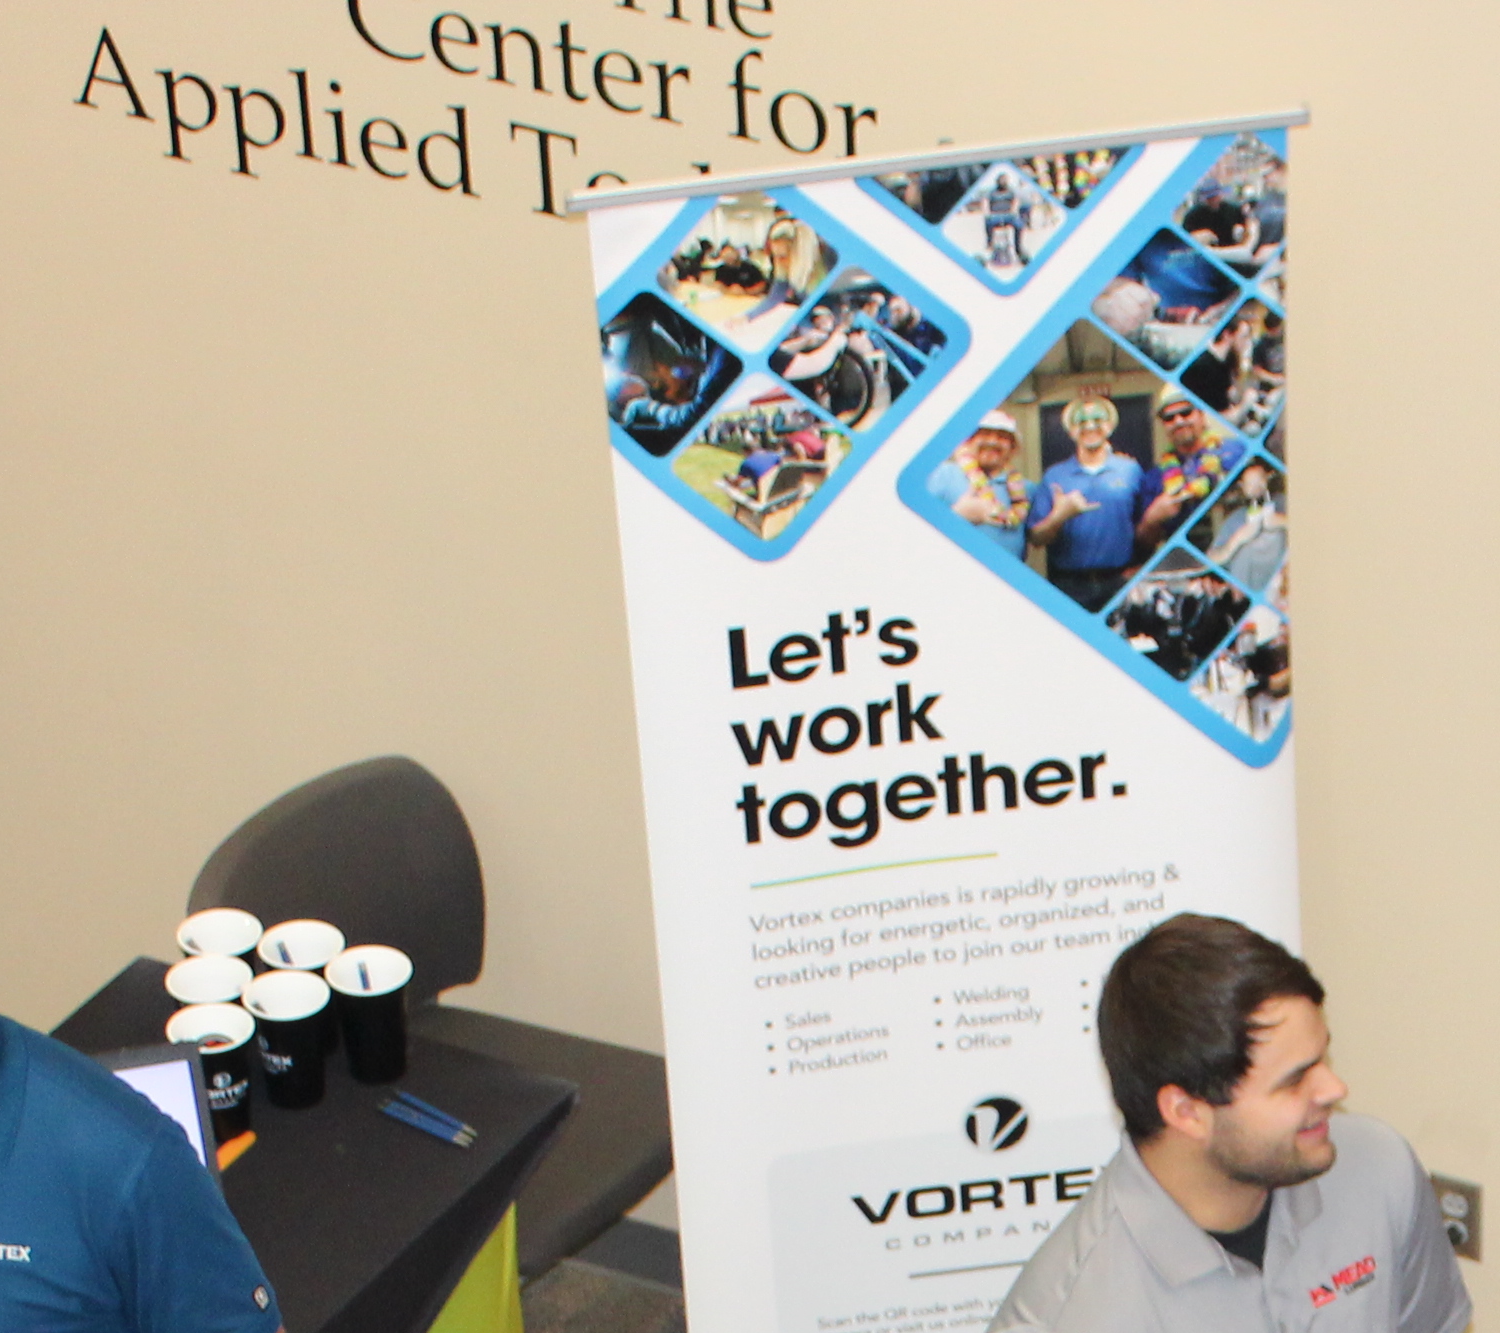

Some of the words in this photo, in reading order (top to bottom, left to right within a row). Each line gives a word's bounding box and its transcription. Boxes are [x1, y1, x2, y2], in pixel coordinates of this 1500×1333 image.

[348, 0, 691, 124] Center
[728, 50, 878, 159] for
[74, 26, 481, 198] Applied
[731, 682, 944, 766] work
[736, 751, 1127, 848] together.
[749, 907, 824, 936] Vortex
[830, 888, 950, 927] companies
[956, 884, 974, 904] is
[980, 876, 1057, 908] rapidly
[1063, 866, 1156, 897] growing
[1163, 863, 1180, 882] &
[750, 934, 835, 967] looking
[840, 928, 872, 948] for
[879, 912, 992, 944] energetic,
[998, 897, 1116, 933] organized,
[1122, 893, 1165, 914] and
[754, 962, 841, 990] creative
[848, 950, 927, 981] people
[933, 947, 957, 965] to
[963, 938, 1003, 964] join
[1010, 938, 1046, 956] our
[1054, 929, 1111, 951] team
[953, 983, 1031, 1010] Welding
[785, 1008, 832, 1030] Sales
[955, 1004, 1043, 1031] Assembly
[787, 1023, 889, 1054] Operations
[956, 1031, 1012, 1052] Office
[788, 1046, 888, 1076] Production
[851, 1167, 1094, 1225] VORTE
[886, 1219, 1052, 1251] COMPAN
[1332, 1255, 1377, 1290] MEAD
[818, 1313, 853, 1331] Scan
[856, 1308, 880, 1327] the
[884, 1305, 910, 1324] QR
[915, 1302, 949, 1319] code
[953, 1297, 984, 1315] with
[930, 1319, 946, 1332] us
